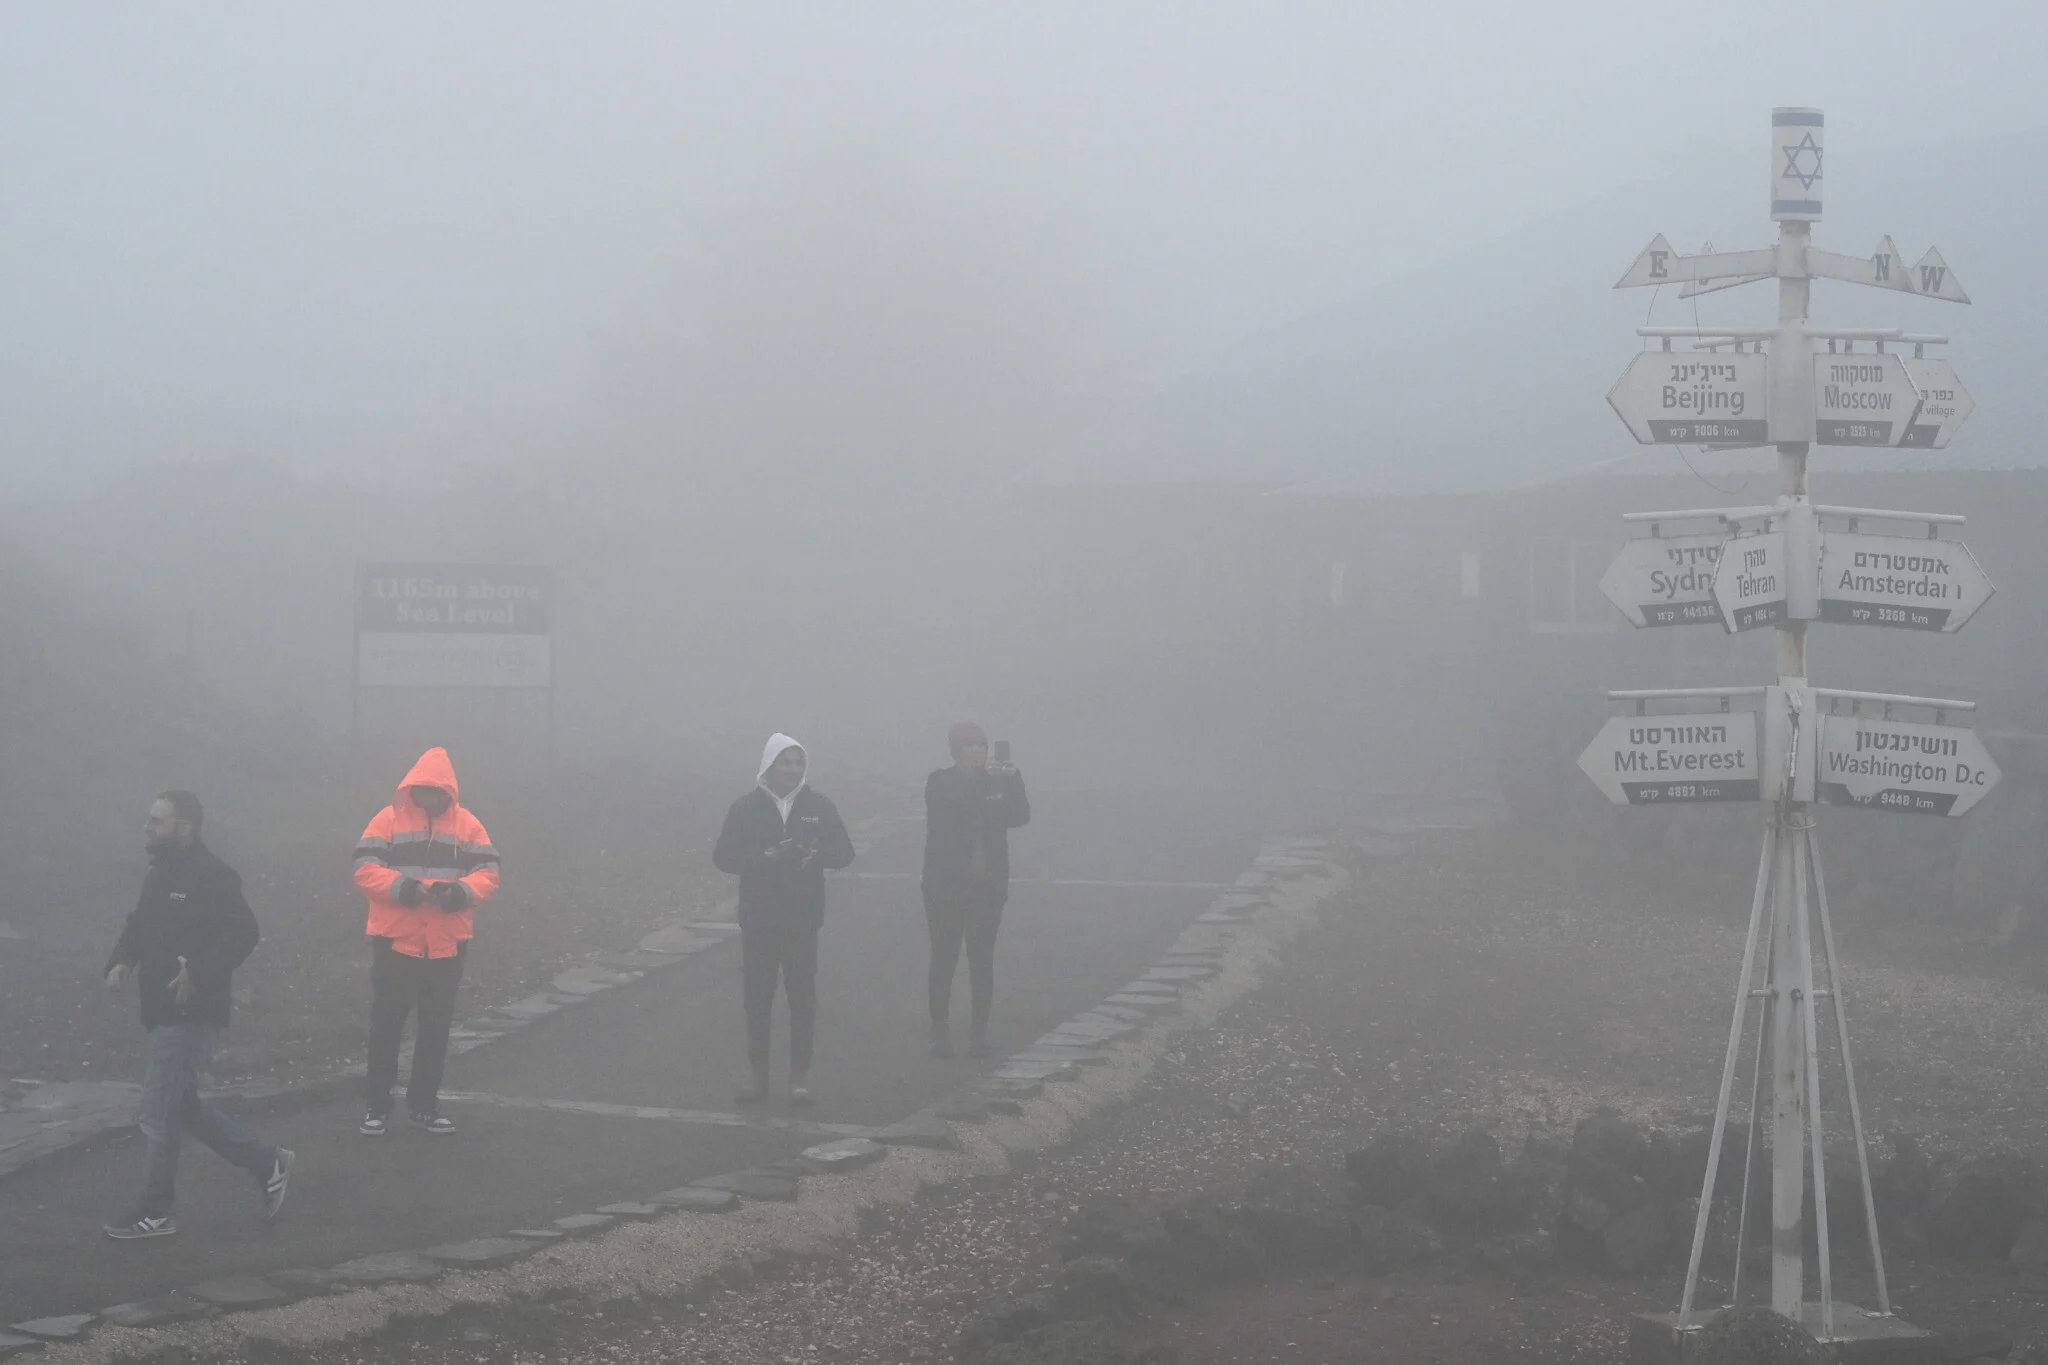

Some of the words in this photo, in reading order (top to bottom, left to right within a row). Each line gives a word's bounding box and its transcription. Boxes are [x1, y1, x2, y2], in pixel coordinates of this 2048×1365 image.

[1648, 250, 1669, 278] E
[1874, 253, 1890, 281] N
[1919, 264, 1946, 292] W
[1671, 361, 1737, 382] בייג'ינג
[1830, 364, 1884, 387] מוסקווה
[1662, 384, 1744, 415] Beijing
[1824, 385, 1892, 410] Moscow
[1931, 389, 1954, 401] כפר
[1926, 404, 1956, 417] village
[1694, 425, 1718, 437] 7006
[1724, 425, 1739, 437] km
[1869, 427, 1881, 439] km
[1667, 546, 1721, 565] סידני
[1743, 548, 1766, 573] טהרן
[1854, 551, 1950, 575] אמסטרדם
[372, 577, 458, 600] 1165m
[466, 578, 540, 600] above
[1650, 566, 1712, 599] Sydn
[1736, 573, 1776, 598] Tehran
[396, 602, 439, 623] Sea
[447, 603, 515, 624] Level
[1878, 608, 1906, 622] 3268
[1912, 613, 1928, 625] km
[1630, 726, 1726, 745] האוורסט
[1855, 730, 1958, 757] וושינגטון
[1614, 748, 1745, 772] Mt.Everest
[1829, 751, 1947, 784] Washington
[1955, 763, 1985, 786] D.c
[1702, 785, 1720, 797] km
[1880, 792, 1910, 806] 9448
[1915, 798, 1934, 809] km
